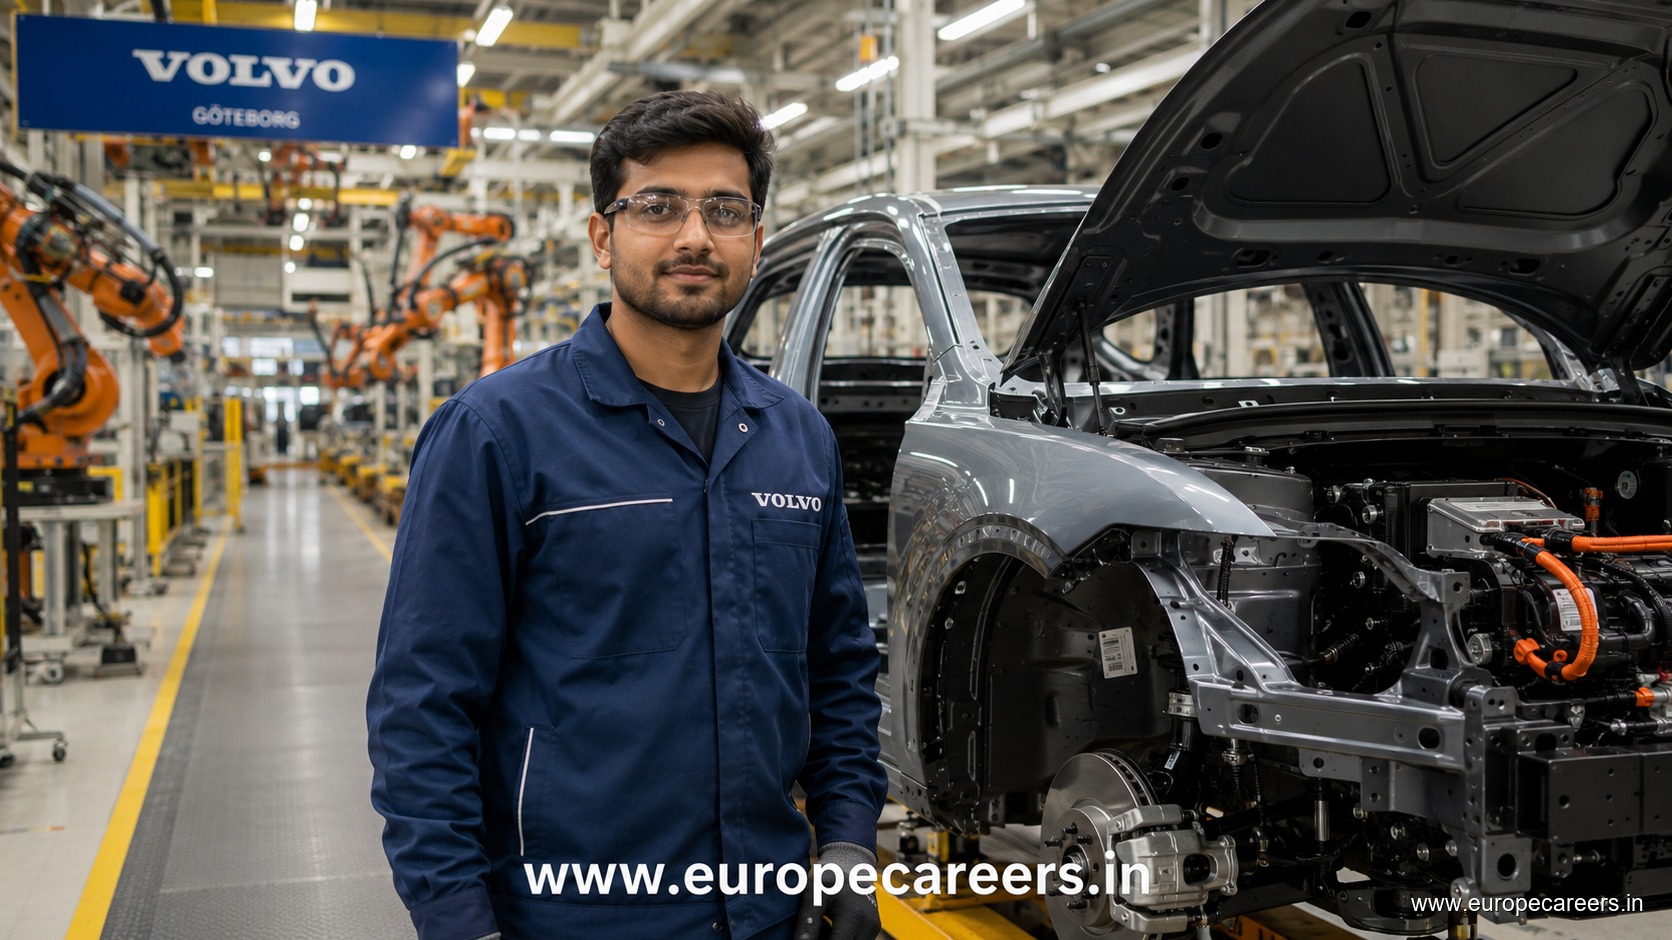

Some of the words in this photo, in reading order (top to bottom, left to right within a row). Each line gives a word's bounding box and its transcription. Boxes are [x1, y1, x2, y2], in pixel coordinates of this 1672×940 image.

[133, 50, 355, 92] VOLVO
[193, 105, 300, 129] GÖTEBORG
[751, 492, 822, 512] VOLVO
